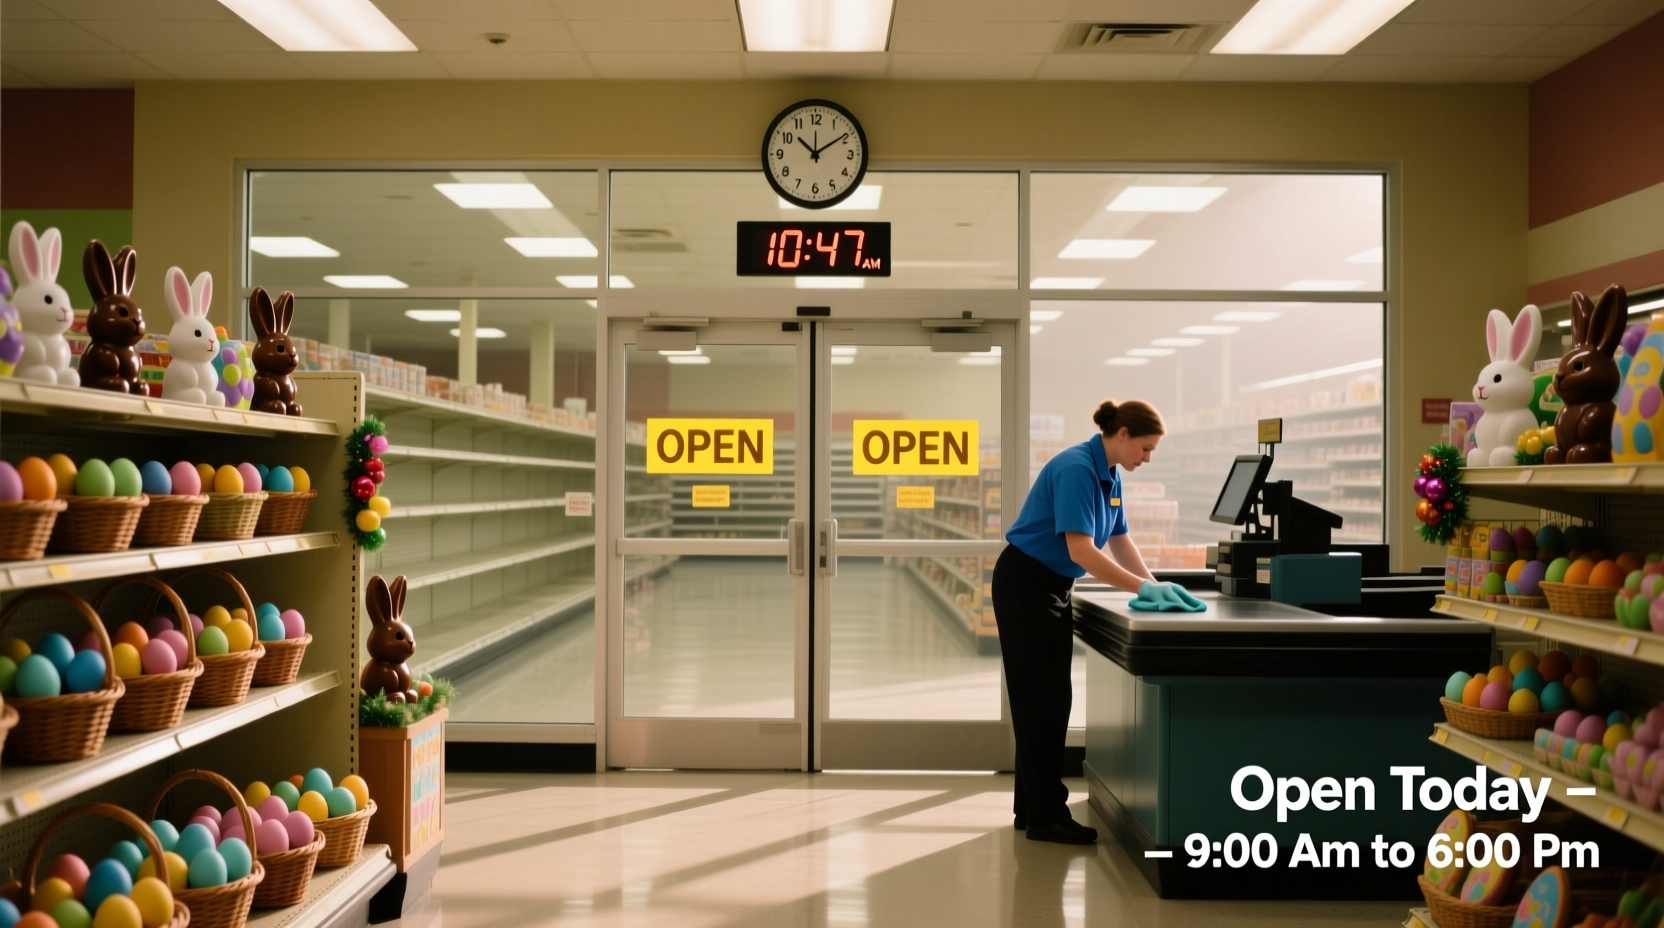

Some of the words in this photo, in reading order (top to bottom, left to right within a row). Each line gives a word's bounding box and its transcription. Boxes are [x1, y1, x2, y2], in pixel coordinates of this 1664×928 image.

[794, 117, 803, 130] 11
[810, 113, 822, 126] 12
[832, 118, 836, 131] 1
[782, 131, 793, 144] 10
[776, 148, 784, 160] 9
[846, 149, 854, 160] 3
[781, 165, 790, 177] 8
[841, 167, 849, 177] 4
[795, 178, 802, 190] 7
[811, 182, 819, 194] 6
[828, 179, 836, 191] 5
[767, 229, 865, 268] 10:47
[862, 257, 881, 270] AM
[656, 428, 764, 464] OPEN
[862, 429, 969, 465] OPEN
